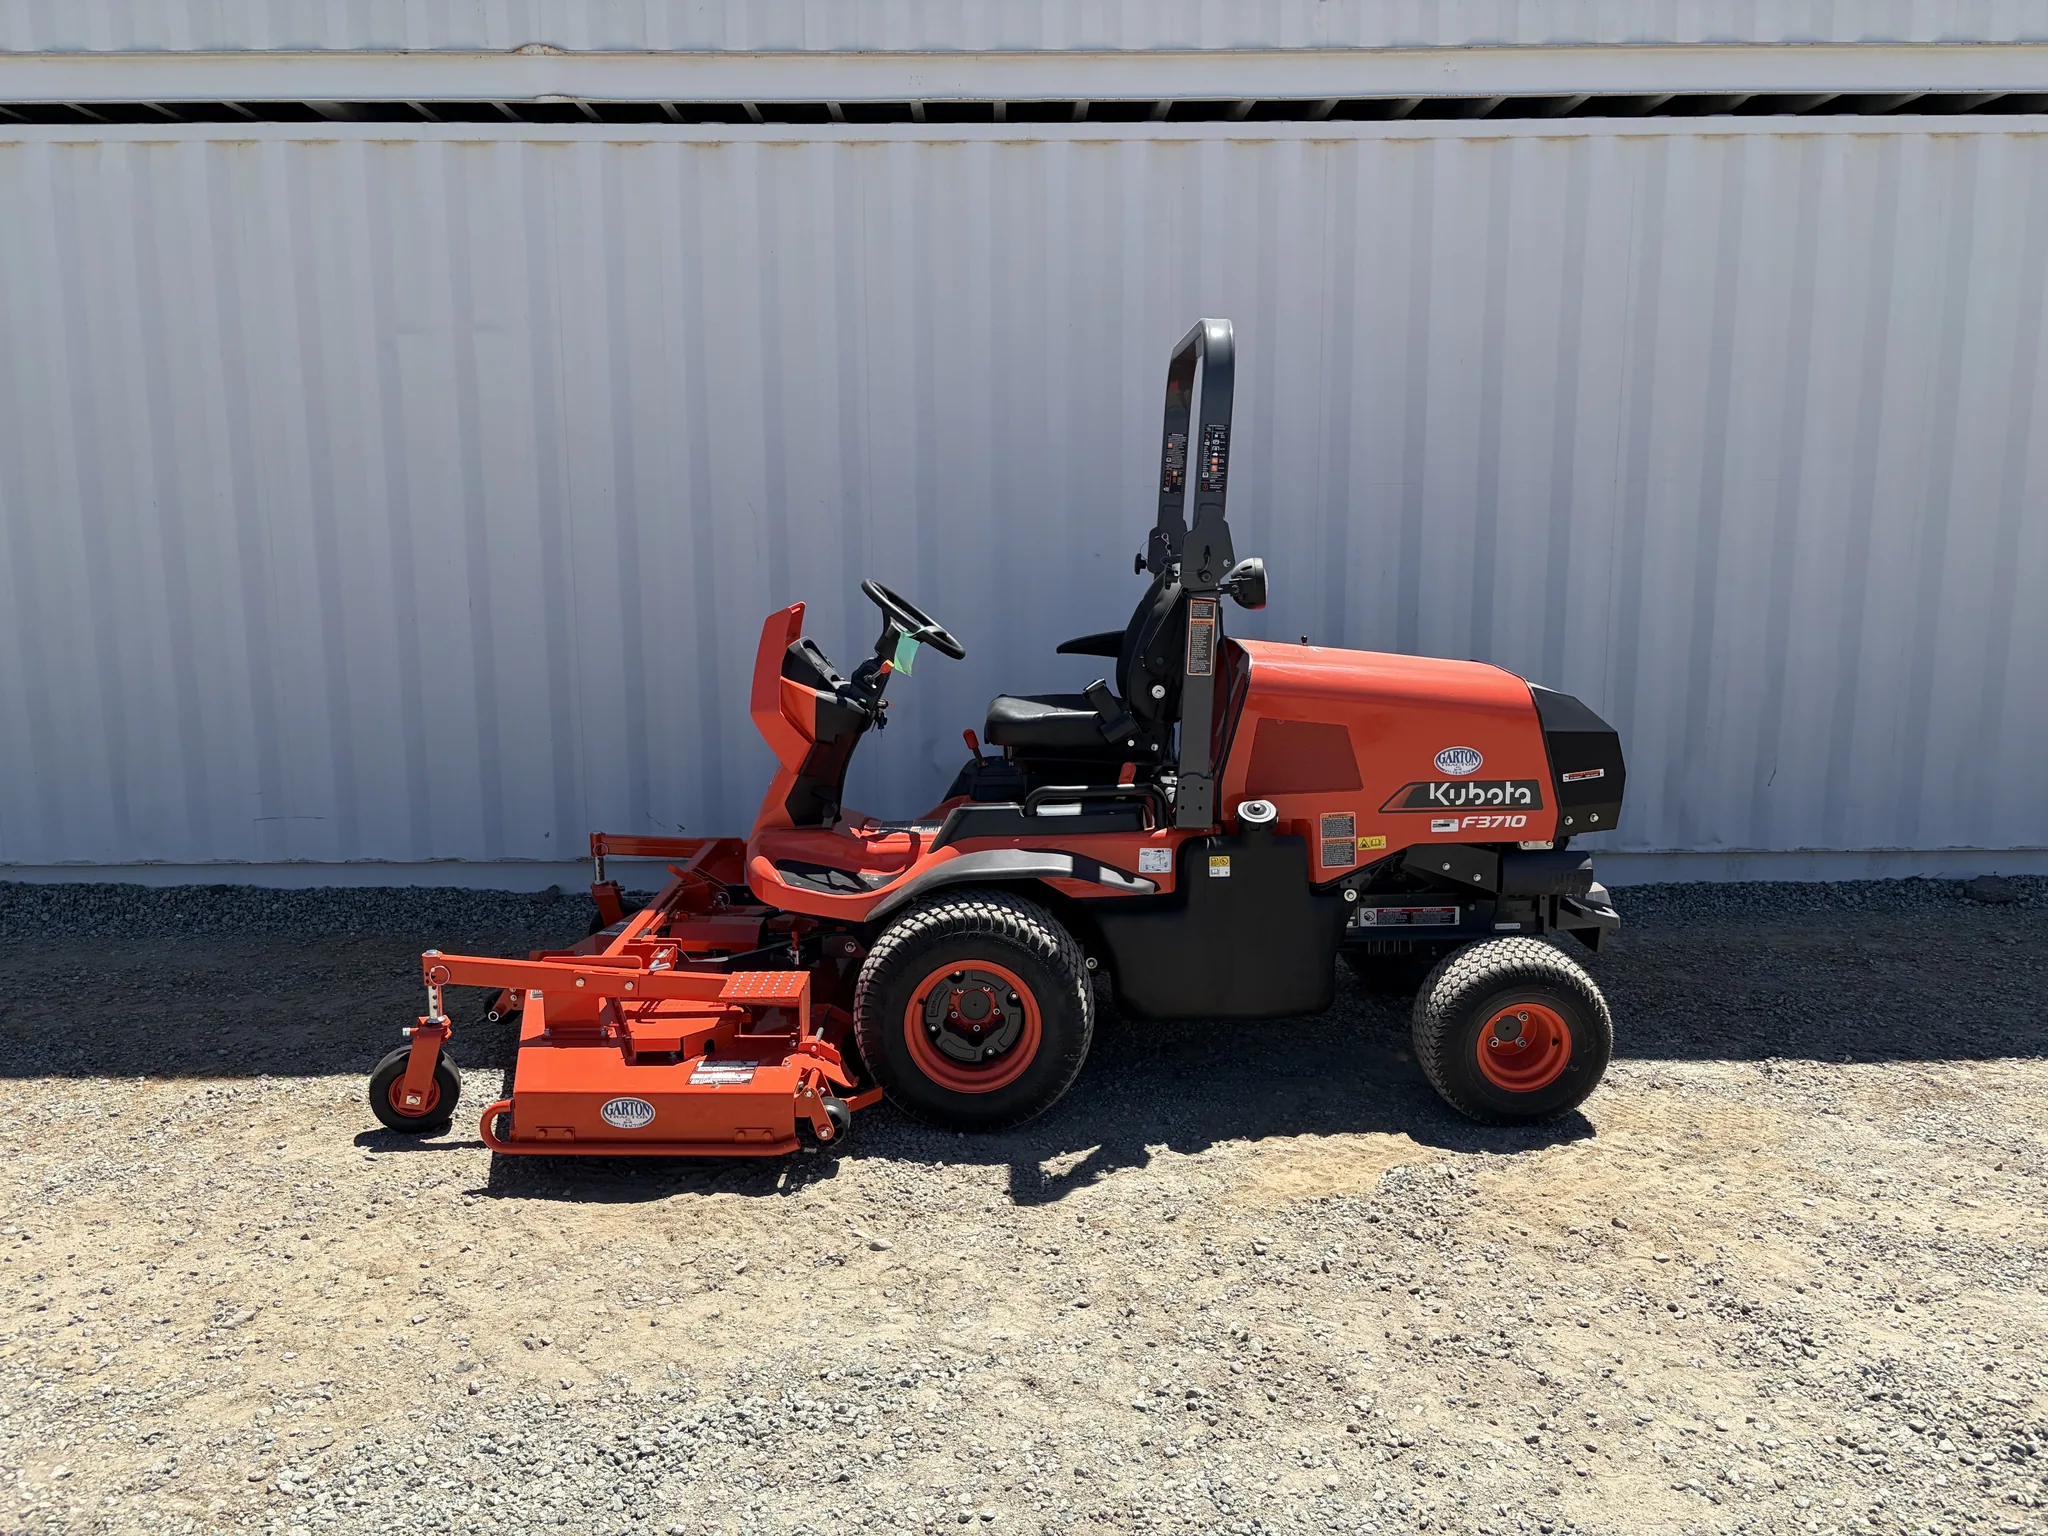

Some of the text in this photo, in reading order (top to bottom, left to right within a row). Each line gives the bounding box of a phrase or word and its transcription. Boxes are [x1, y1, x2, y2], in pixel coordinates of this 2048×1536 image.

[1438, 750, 1478, 764] GARTON
[1429, 781, 1531, 806] Kubota
[1461, 815, 1527, 829] F3710
[605, 1101, 650, 1116] GARTON
